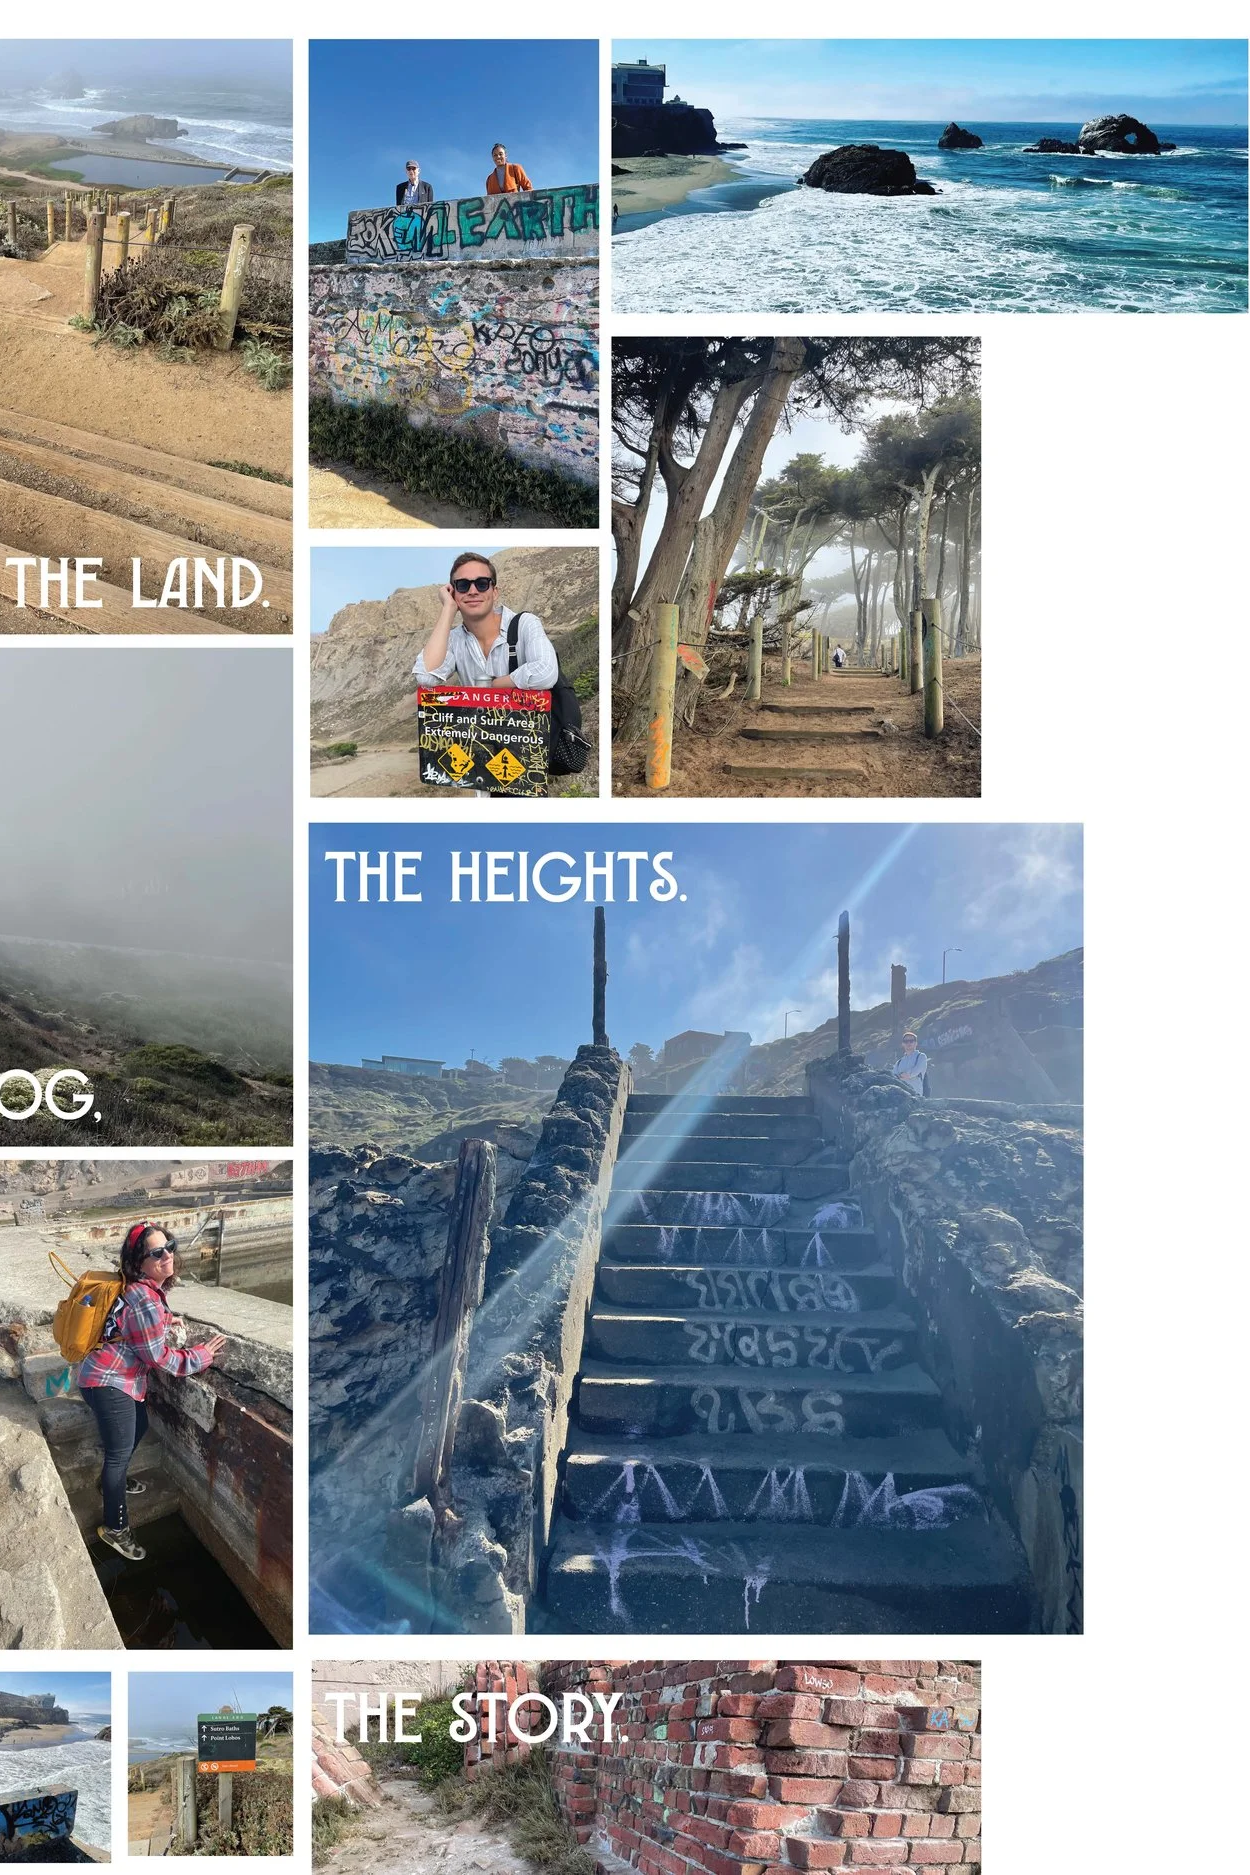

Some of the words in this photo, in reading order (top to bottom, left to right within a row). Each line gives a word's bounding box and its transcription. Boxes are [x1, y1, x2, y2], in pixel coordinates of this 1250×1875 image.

[432, 712, 454, 723] Cliff
[457, 715, 477, 725] and
[481, 716, 506, 727] Surf
[507, 717, 535, 729] Area
[425, 726, 478, 741] Extremely
[481, 731, 544, 745] Dangerous
